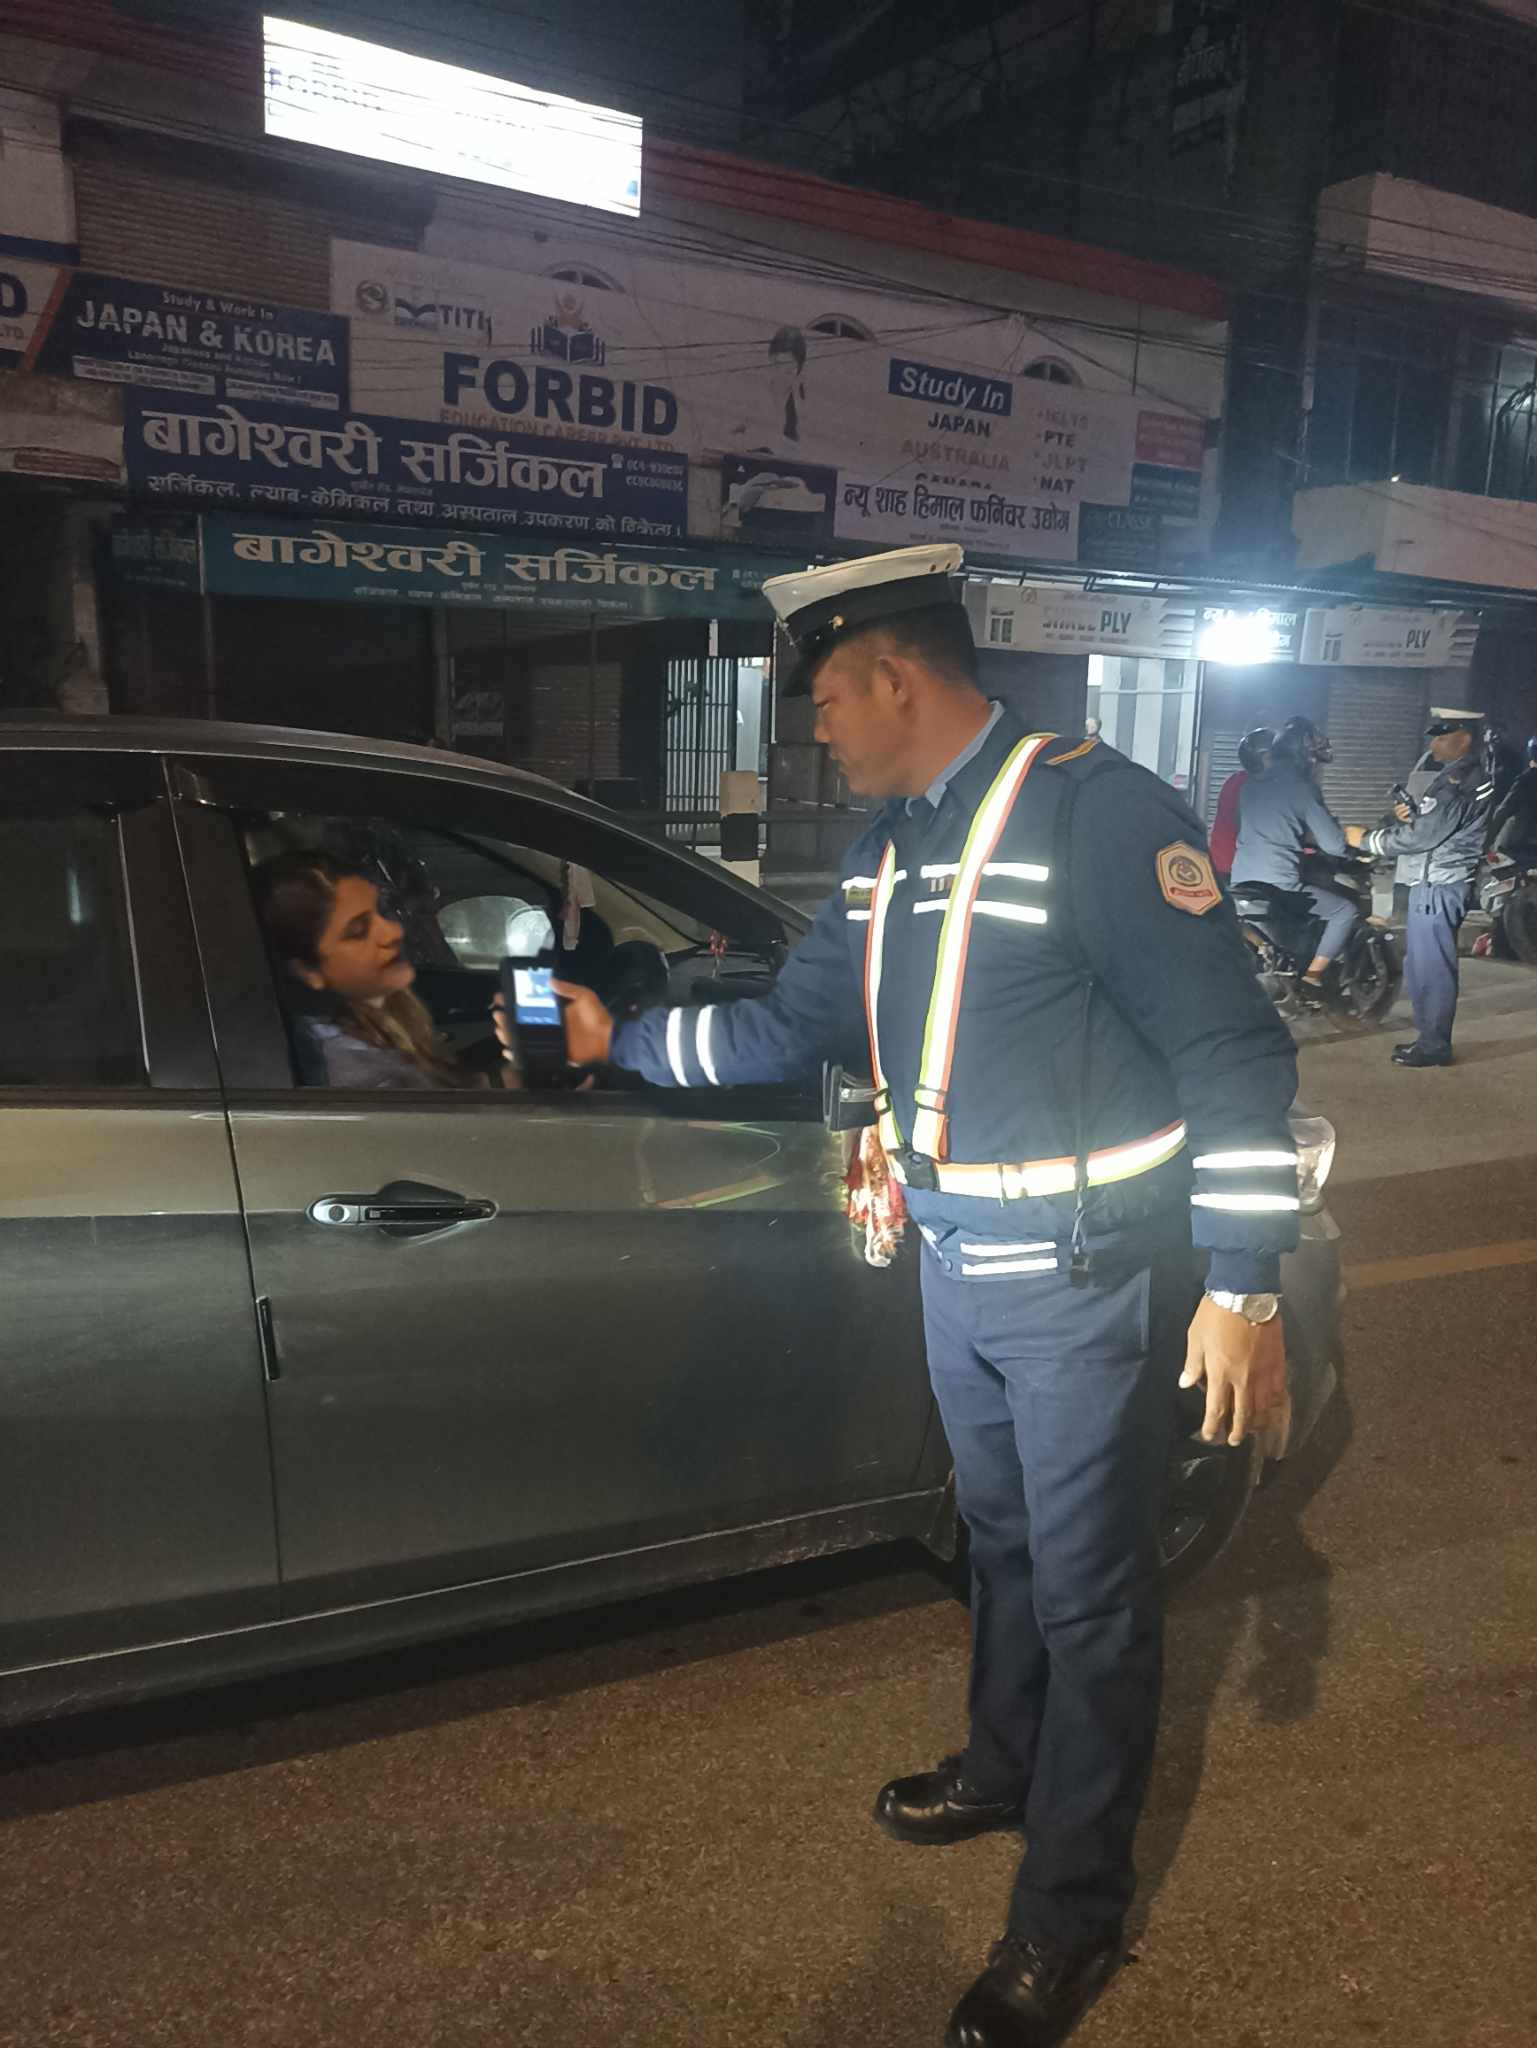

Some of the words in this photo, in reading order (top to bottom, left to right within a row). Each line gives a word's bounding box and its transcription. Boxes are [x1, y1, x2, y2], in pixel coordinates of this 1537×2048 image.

[162, 291, 201, 312] Study
[221, 301, 255, 319] Work
[260, 307, 274, 320] In
[76, 300, 188, 343] JAPAN
[199, 319, 224, 349] &
[233, 325, 337, 367] KOREA
[442, 352, 678, 437] FORBID
[900, 367, 978, 407] Study
[981, 385, 1005, 411] In
[928, 412, 992, 438] JAPAN
[1044, 429, 1077, 447] PTE
[141, 404, 382, 475] बागेश्वरी
[400, 432, 608, 498] सर्जिकल
[901, 440, 1011, 473] AUSTRALIA
[1039, 477, 1076, 494] NAT
[397, 499, 436, 517] तथा
[441, 503, 518, 524] अस्पताल
[523, 511, 591, 531] उपकरण
[843, 483, 871, 518] न्यू
[875, 486, 909, 516] शाह
[912, 483, 965, 522] हिमाल
[232, 530, 486, 577] बागेश्वरी
[504, 548, 719, 592] सर्जिकल
[1100, 610, 1133, 635] PLY
[1405, 629, 1432, 649] PLY
